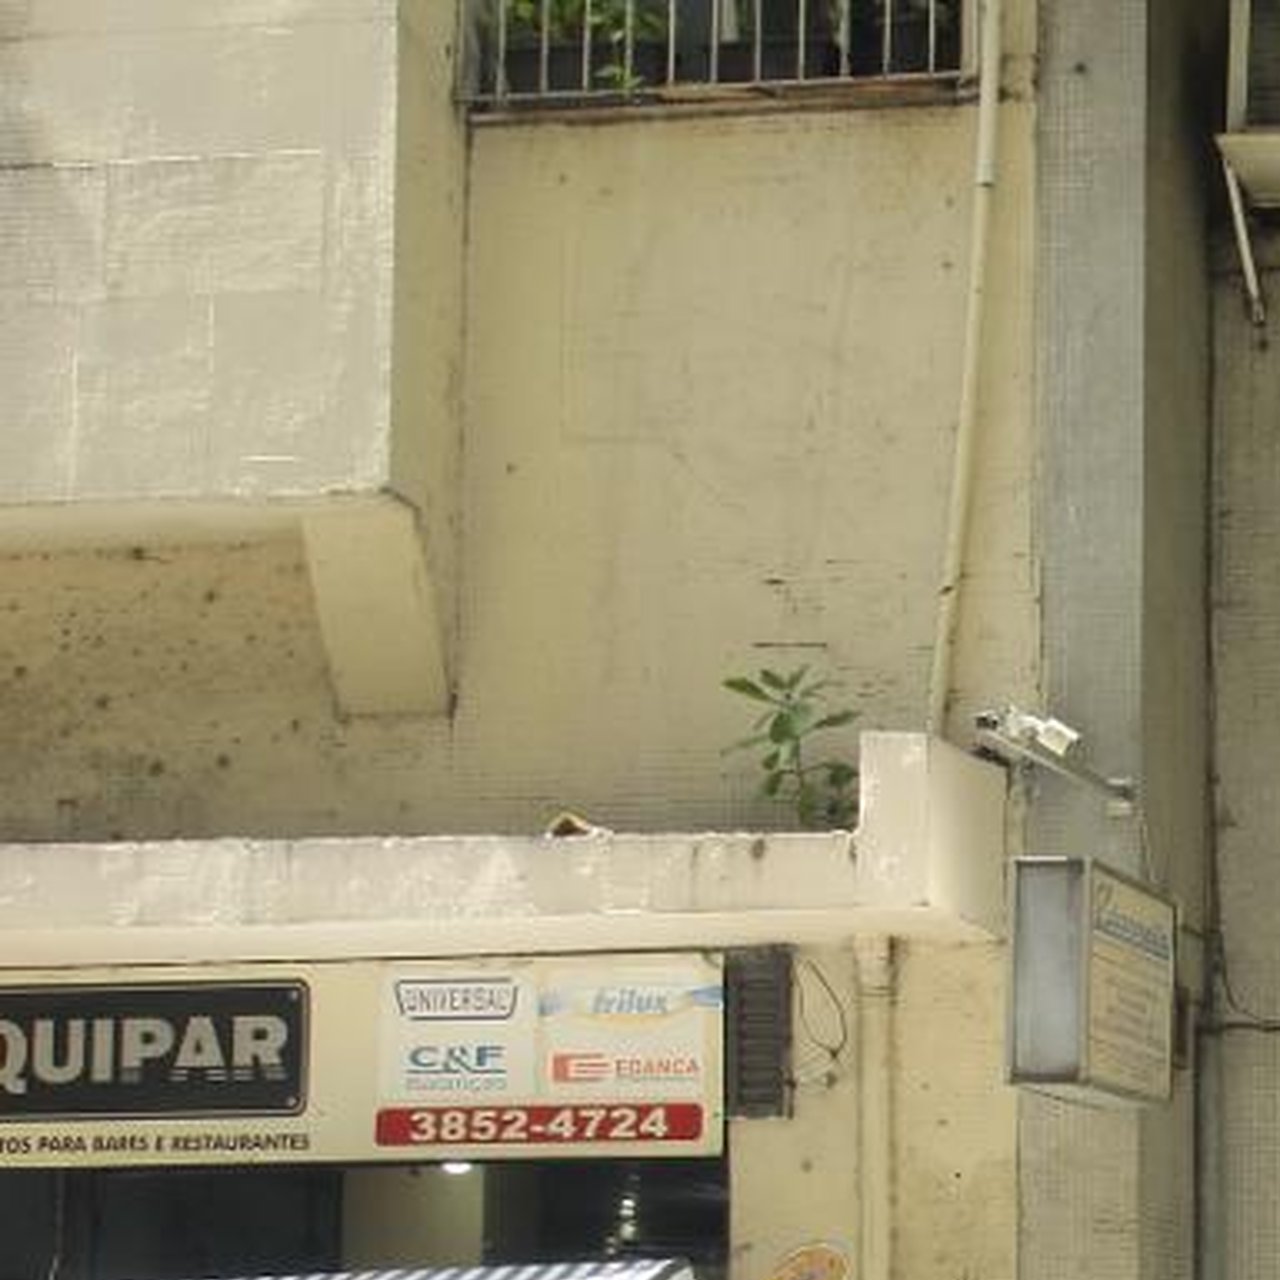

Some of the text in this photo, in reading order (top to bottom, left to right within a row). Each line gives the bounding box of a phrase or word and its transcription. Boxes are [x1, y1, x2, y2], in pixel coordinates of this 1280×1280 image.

[408, 1045, 507, 1074] C&F
[409, 1107, 668, 1142] 3852-4724
[38, 1135, 87, 1153] PARA
[172, 1132, 310, 1151] RESTAURANTES
